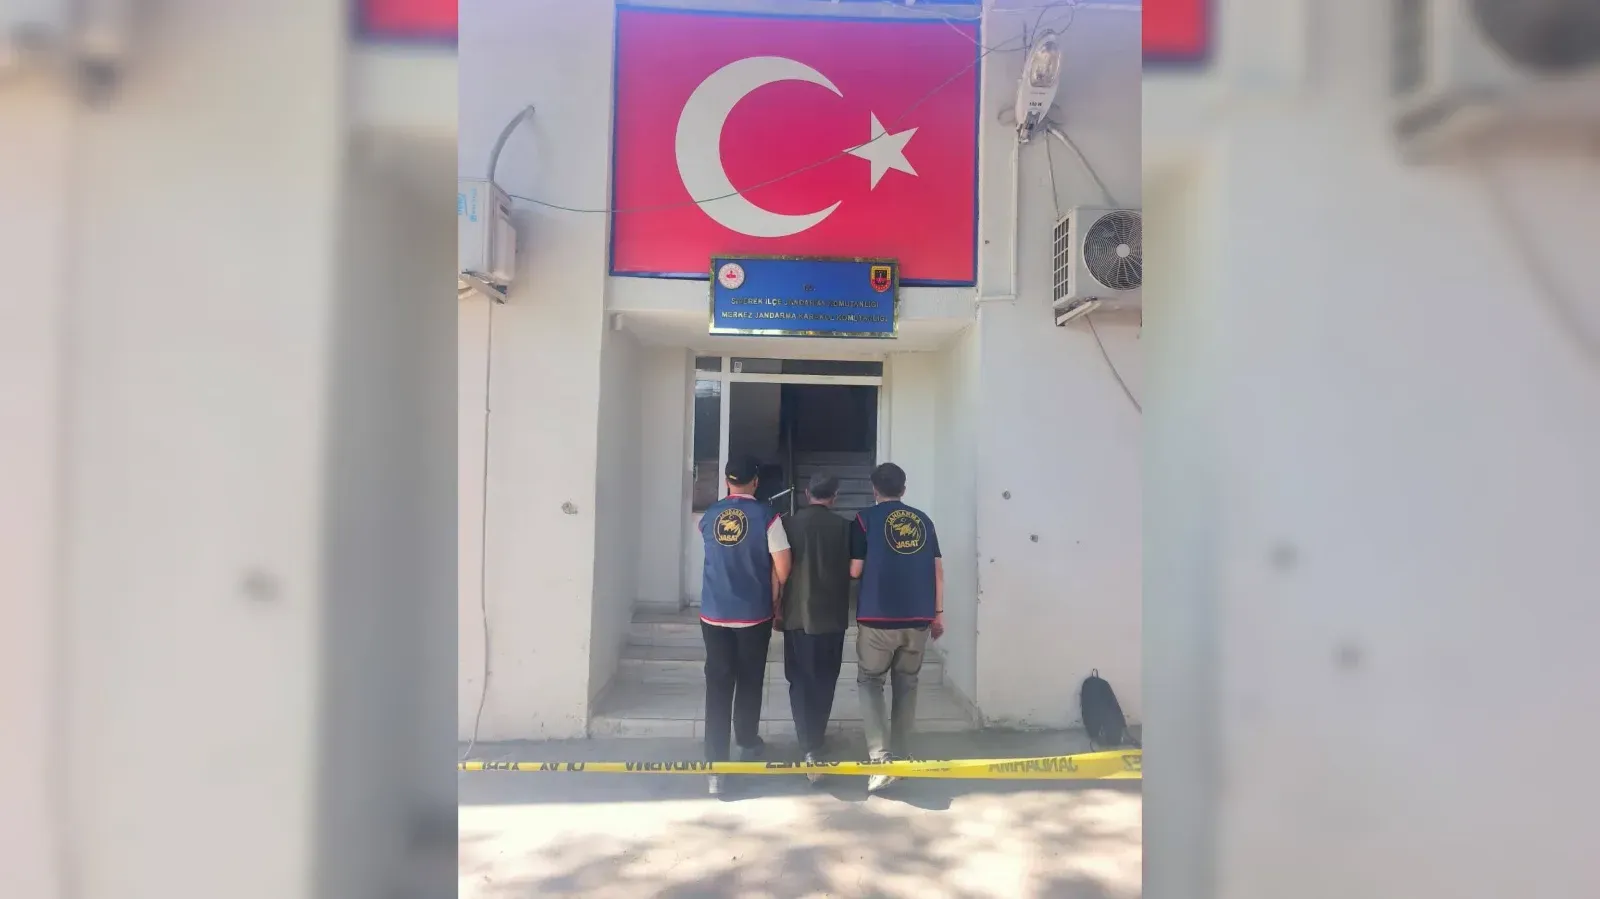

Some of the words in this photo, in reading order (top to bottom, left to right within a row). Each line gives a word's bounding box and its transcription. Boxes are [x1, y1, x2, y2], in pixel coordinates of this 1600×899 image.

[721, 311, 753, 319] MERKEZ
[755, 311, 796, 319] JANDARMA
[887, 511, 921, 526] JANDARMA
[895, 539, 919, 549] JASAT
